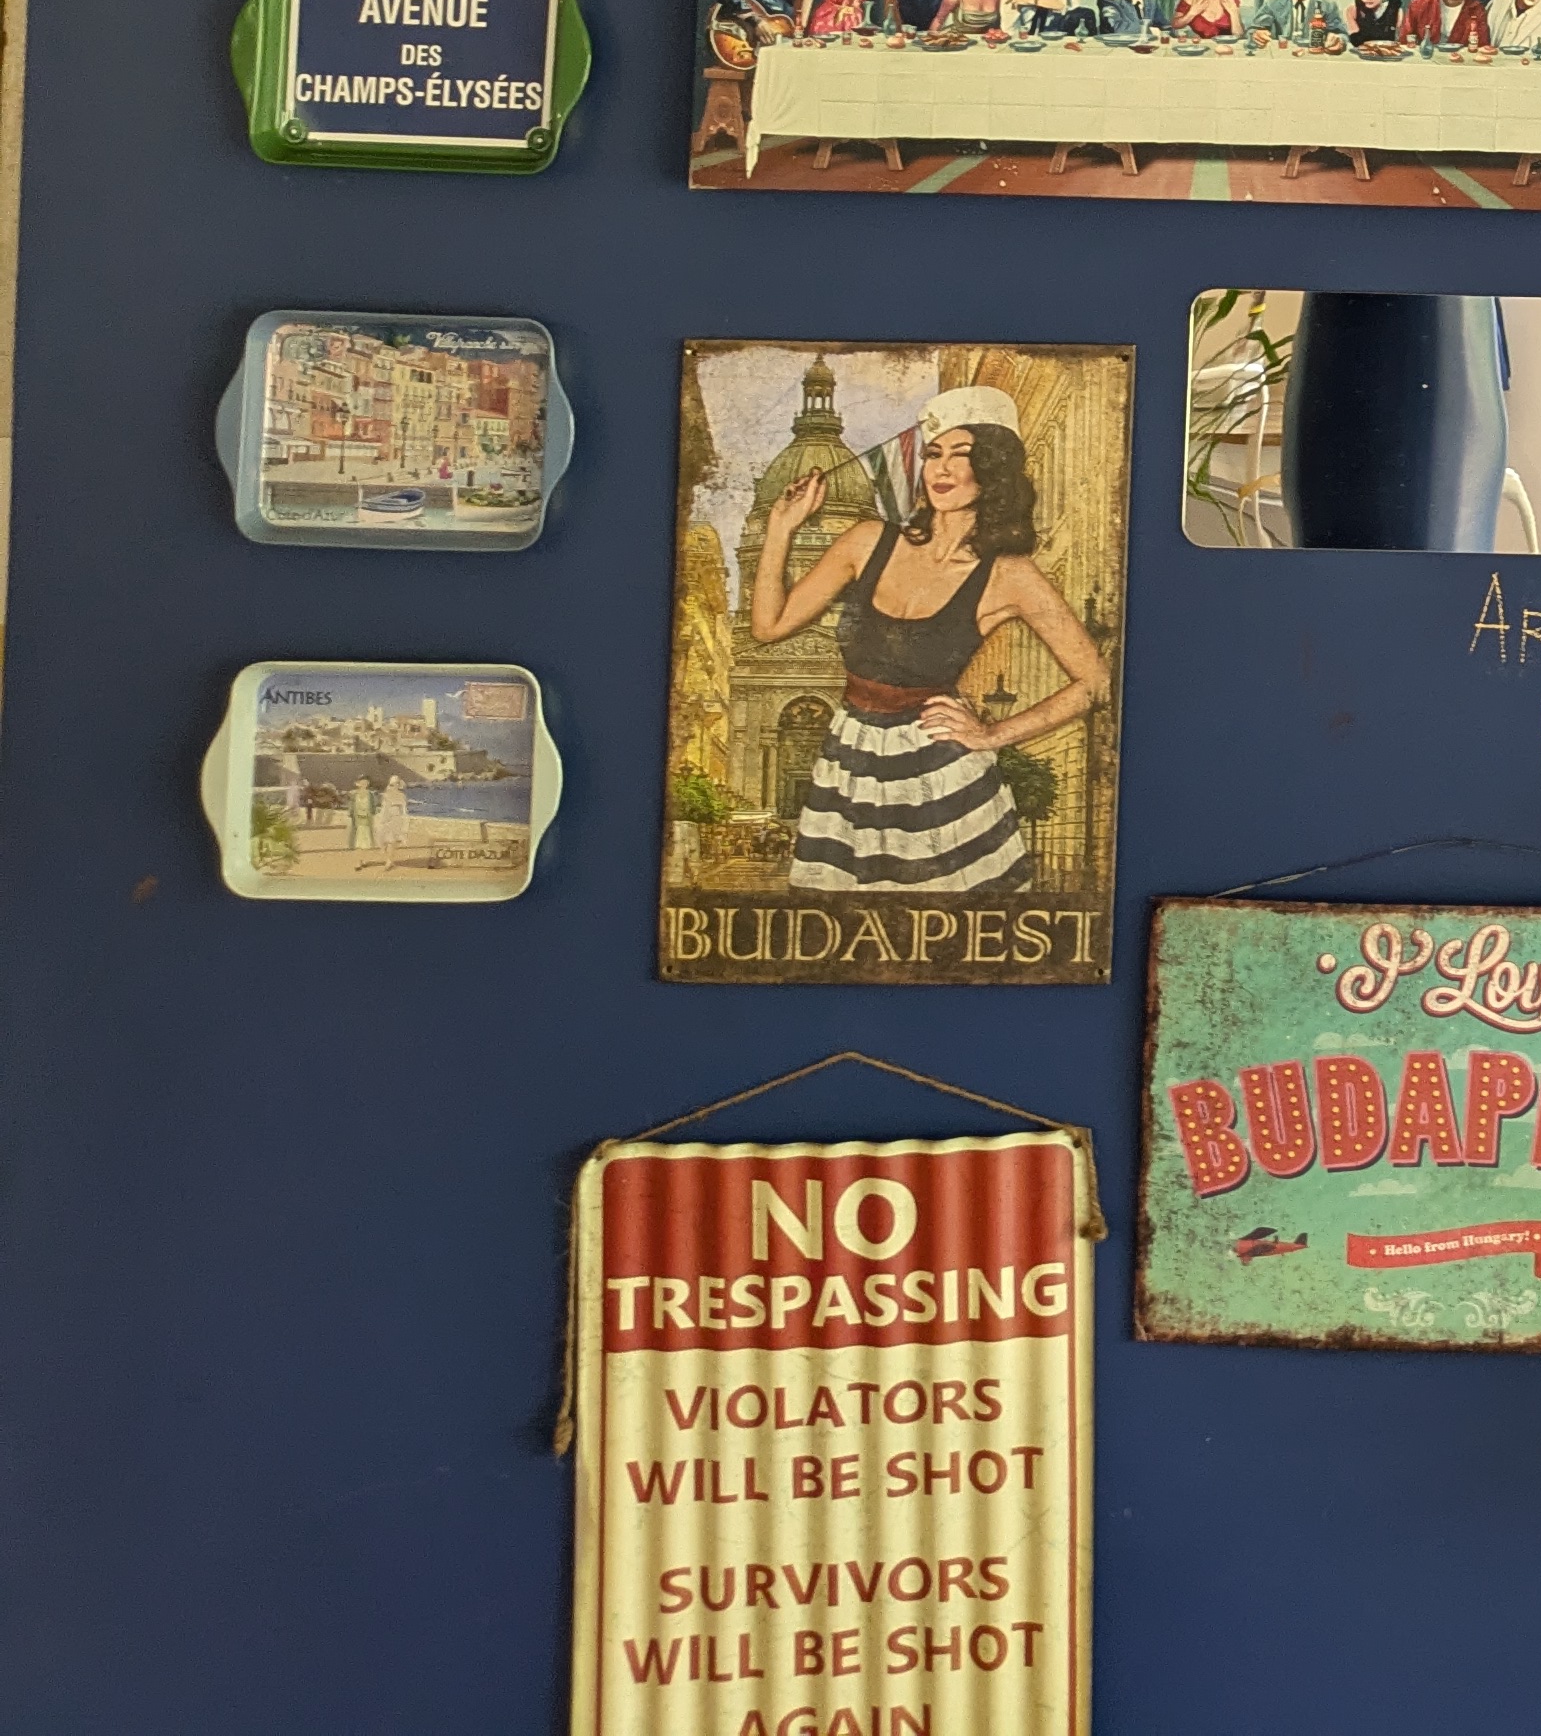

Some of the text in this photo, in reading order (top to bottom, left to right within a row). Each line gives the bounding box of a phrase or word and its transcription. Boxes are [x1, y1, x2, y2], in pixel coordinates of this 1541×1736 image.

[400, 43, 443, 67] DES
[295, 72, 543, 111] CHAMPS-ÉLYSÉES
[260, 687, 333, 706] ANTIBES
[664, 906, 1102, 963] BUDAPEST
[751, 1177, 918, 1261] NO
[1384, 1229, 1531, 1256] Hello from Hungary!
[607, 1262, 1069, 1331] TRESPASSING
[665, 1378, 1003, 1431] VIOLATORS
[626, 1445, 1045, 1506] WILL BE SHOT
[659, 1556, 1010, 1614] SURVIVORS
[623, 1622, 1045, 1686] WILL BE SHOT
[738, 1703, 932, 1736] AGAIN
